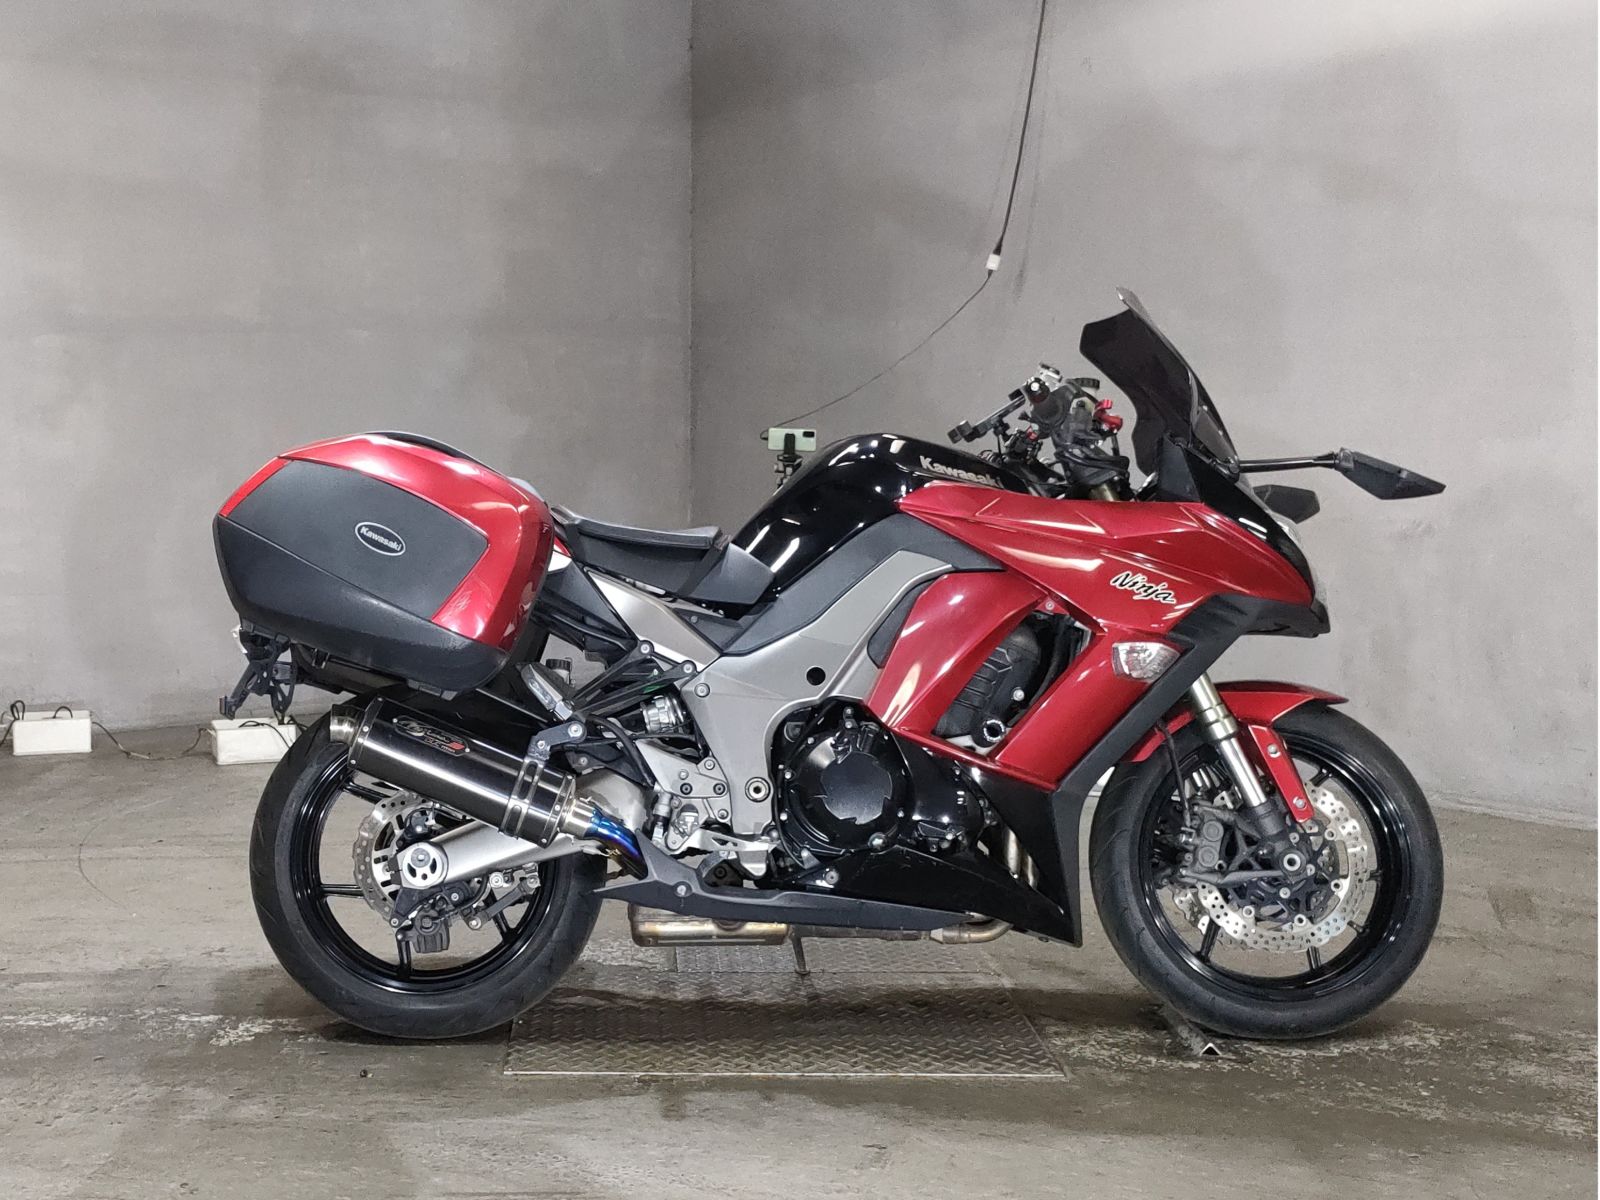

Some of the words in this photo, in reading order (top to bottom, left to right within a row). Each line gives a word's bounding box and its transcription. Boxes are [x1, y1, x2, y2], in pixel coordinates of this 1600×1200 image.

[919, 455, 1004, 489] Kawasaki
[360, 526, 402, 551] Kawasaki
[1110, 570, 1176, 604] Ninja
